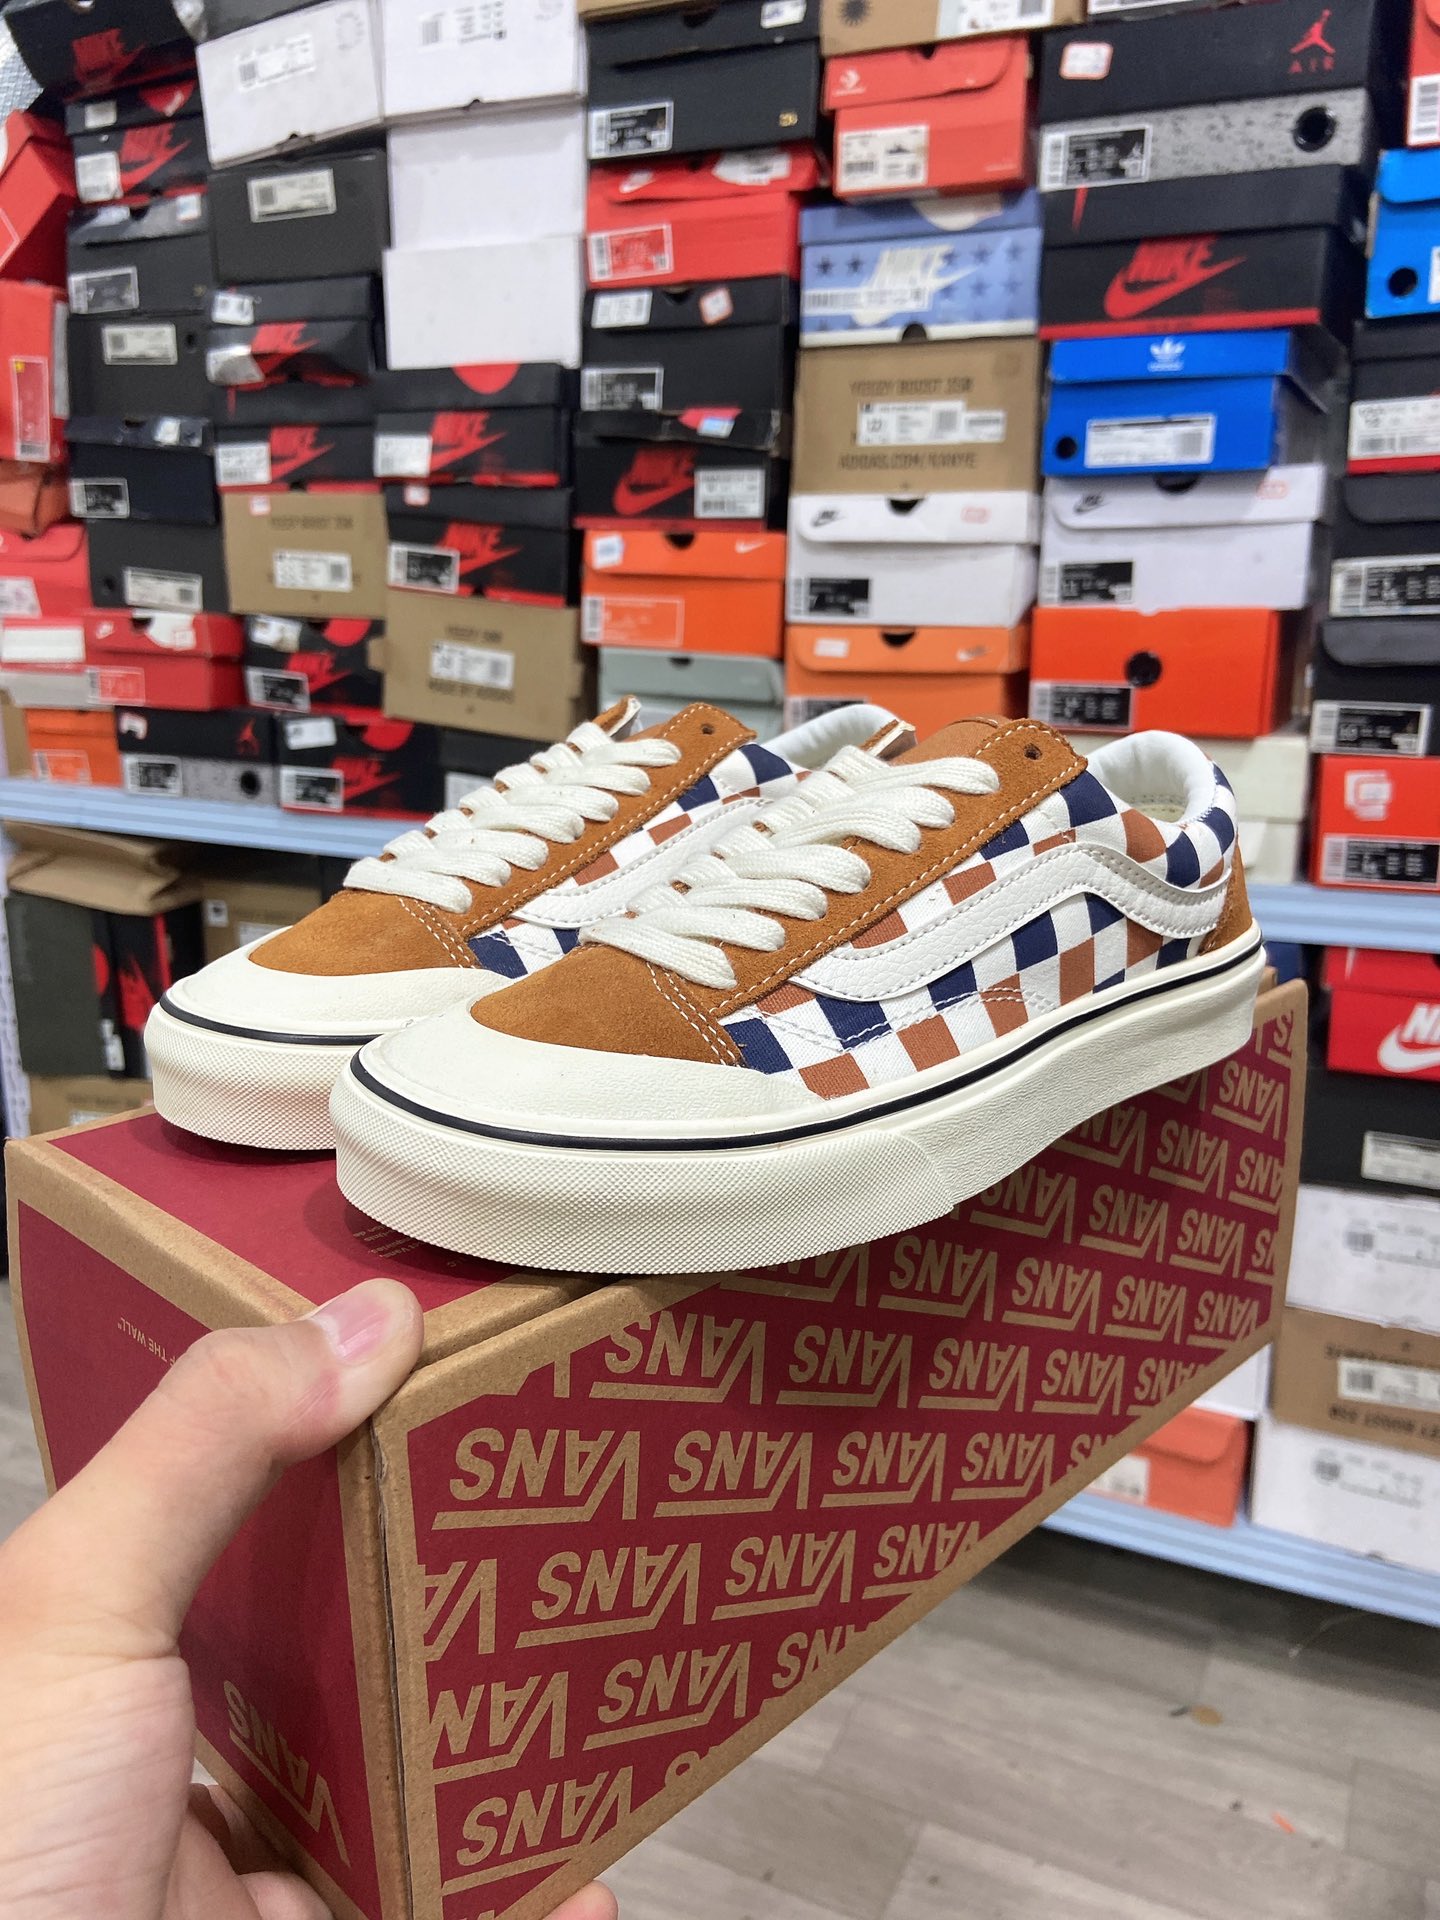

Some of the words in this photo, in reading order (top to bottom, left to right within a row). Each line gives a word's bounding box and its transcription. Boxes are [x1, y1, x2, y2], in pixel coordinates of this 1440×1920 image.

[1211, 1060, 1285, 1141] VANS
[1148, 1119, 1229, 1199] VANS
[1080, 1185, 1168, 1263] VANS
[1169, 1208, 1245, 1279] VANS
[878, 1235, 998, 1322] VANS
[1002, 1257, 1102, 1335] VANS
[1103, 1275, 1187, 1345] VANS
[148, 1337, 168, 1363] THE
[589, 1311, 766, 1405] VANS
[1187, 1290, 1259, 1350] VANS
[776, 1325, 913, 1409] VANS
[918, 1338, 1029, 1412] VANS
[1032, 1349, 1125, 1415] VANS
[432, 1427, 640, 1530] VANS
[653, 1431, 813, 1518] VANS
[820, 1431, 947, 1508] VANS
[951, 1432, 1055, 1500] VANS
[515, 1542, 702, 1649] VANS
[712, 1530, 857, 1620] VANS
[430, 1671, 569, 1784] VAN
[583, 1641, 752, 1750] VANS
[223, 1680, 351, 1868] VANS
